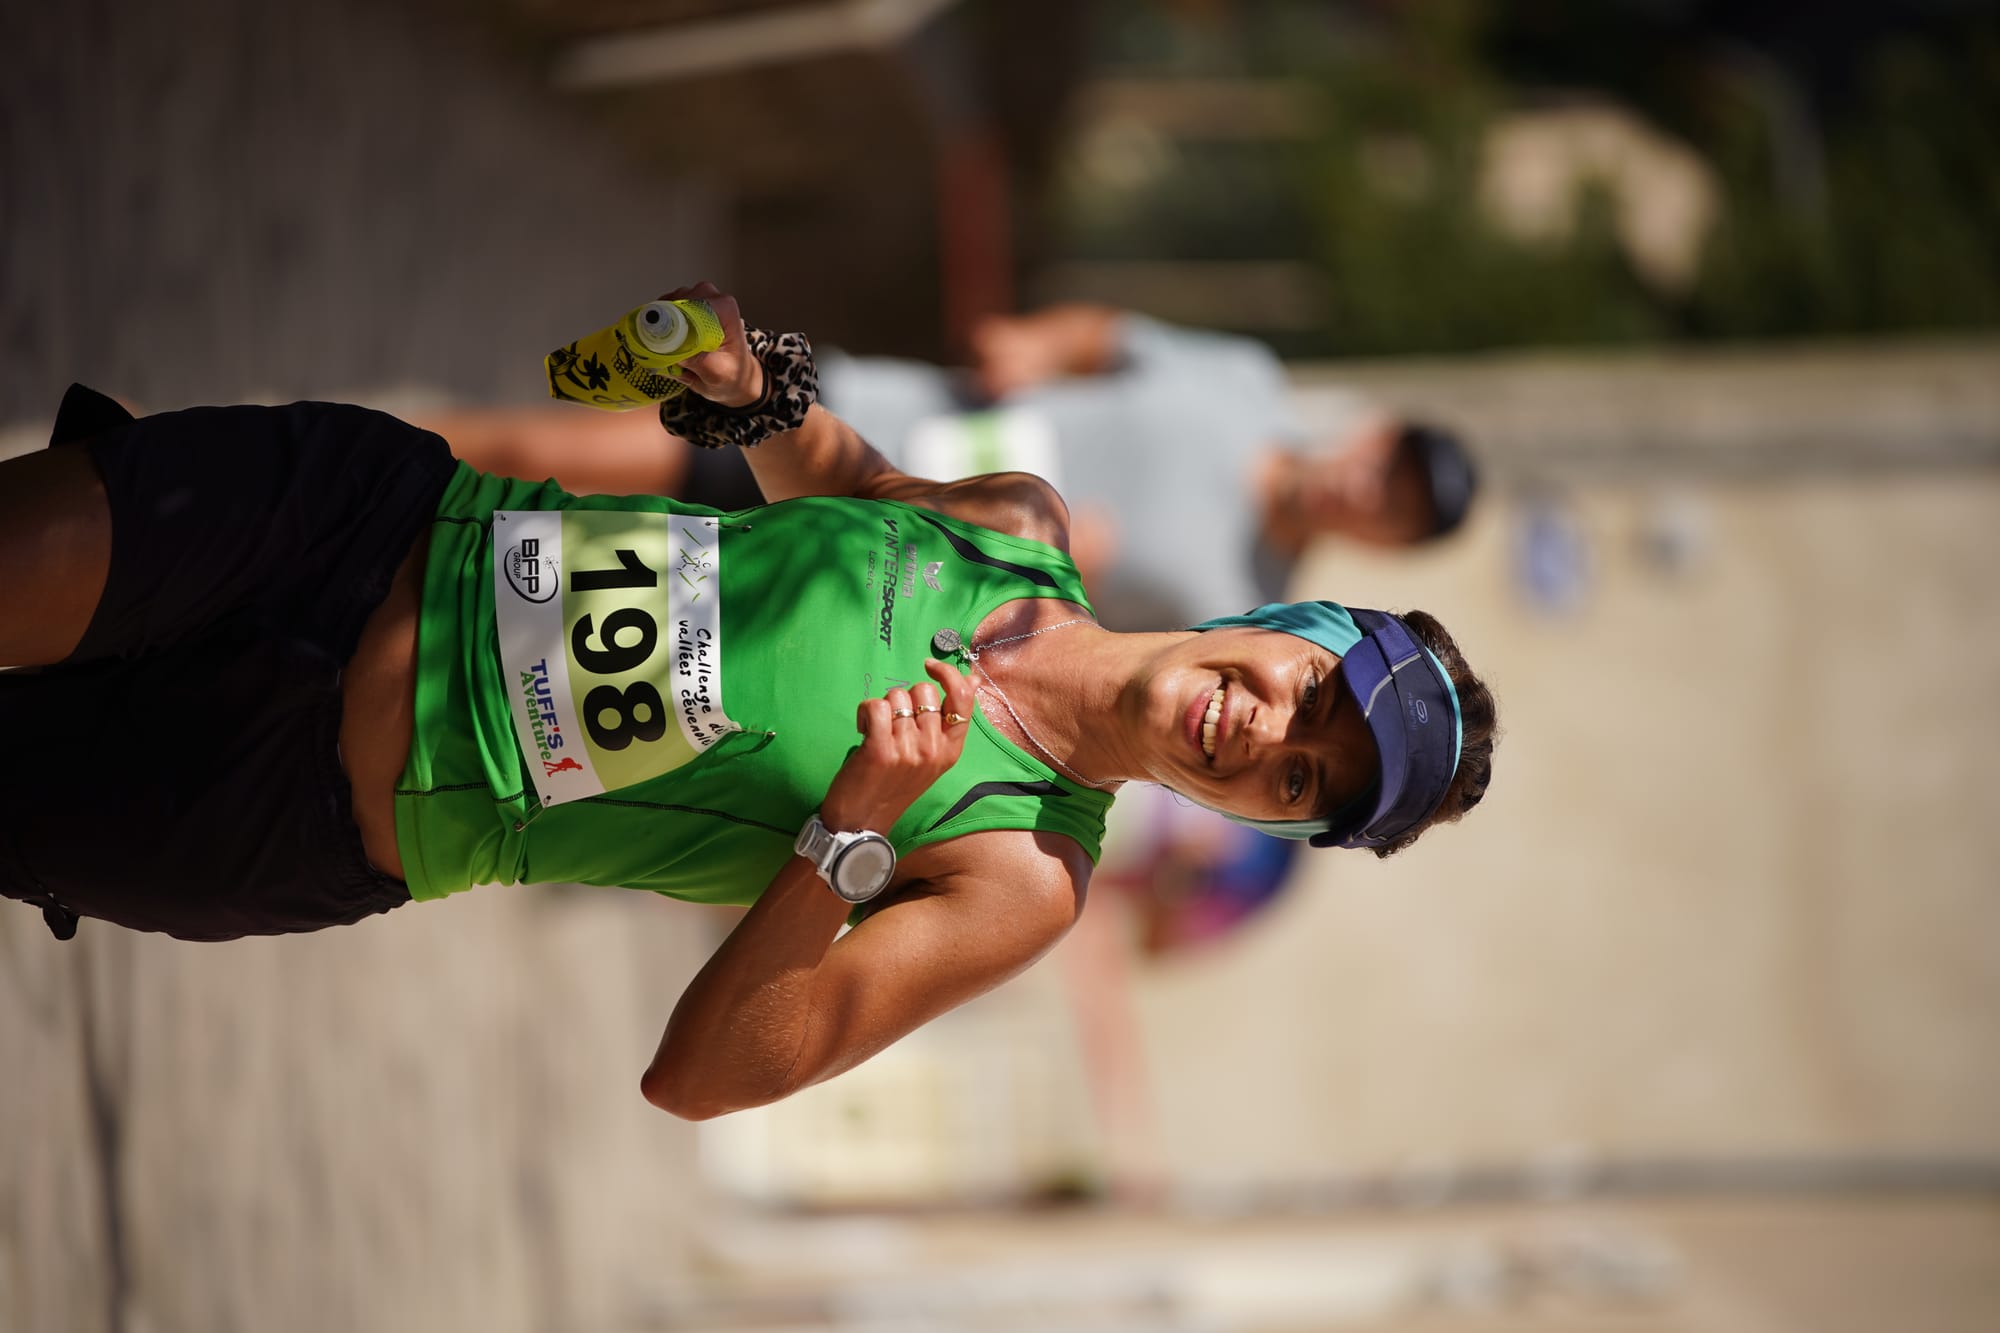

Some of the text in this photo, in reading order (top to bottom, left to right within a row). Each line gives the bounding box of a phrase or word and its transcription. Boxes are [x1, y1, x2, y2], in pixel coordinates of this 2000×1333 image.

[513, 551, 521, 579] GROUP
[521, 538, 540, 594] BFP
[879, 530, 900, 647] INTERSPORT
[903, 544, 917, 598] erima
[570, 549, 667, 751] 198
[678, 619, 695, 677] vallées
[696, 628, 712, 714] Challenge
[520, 671, 552, 761] Aventure
[530, 658, 564, 750] TUFF'S
